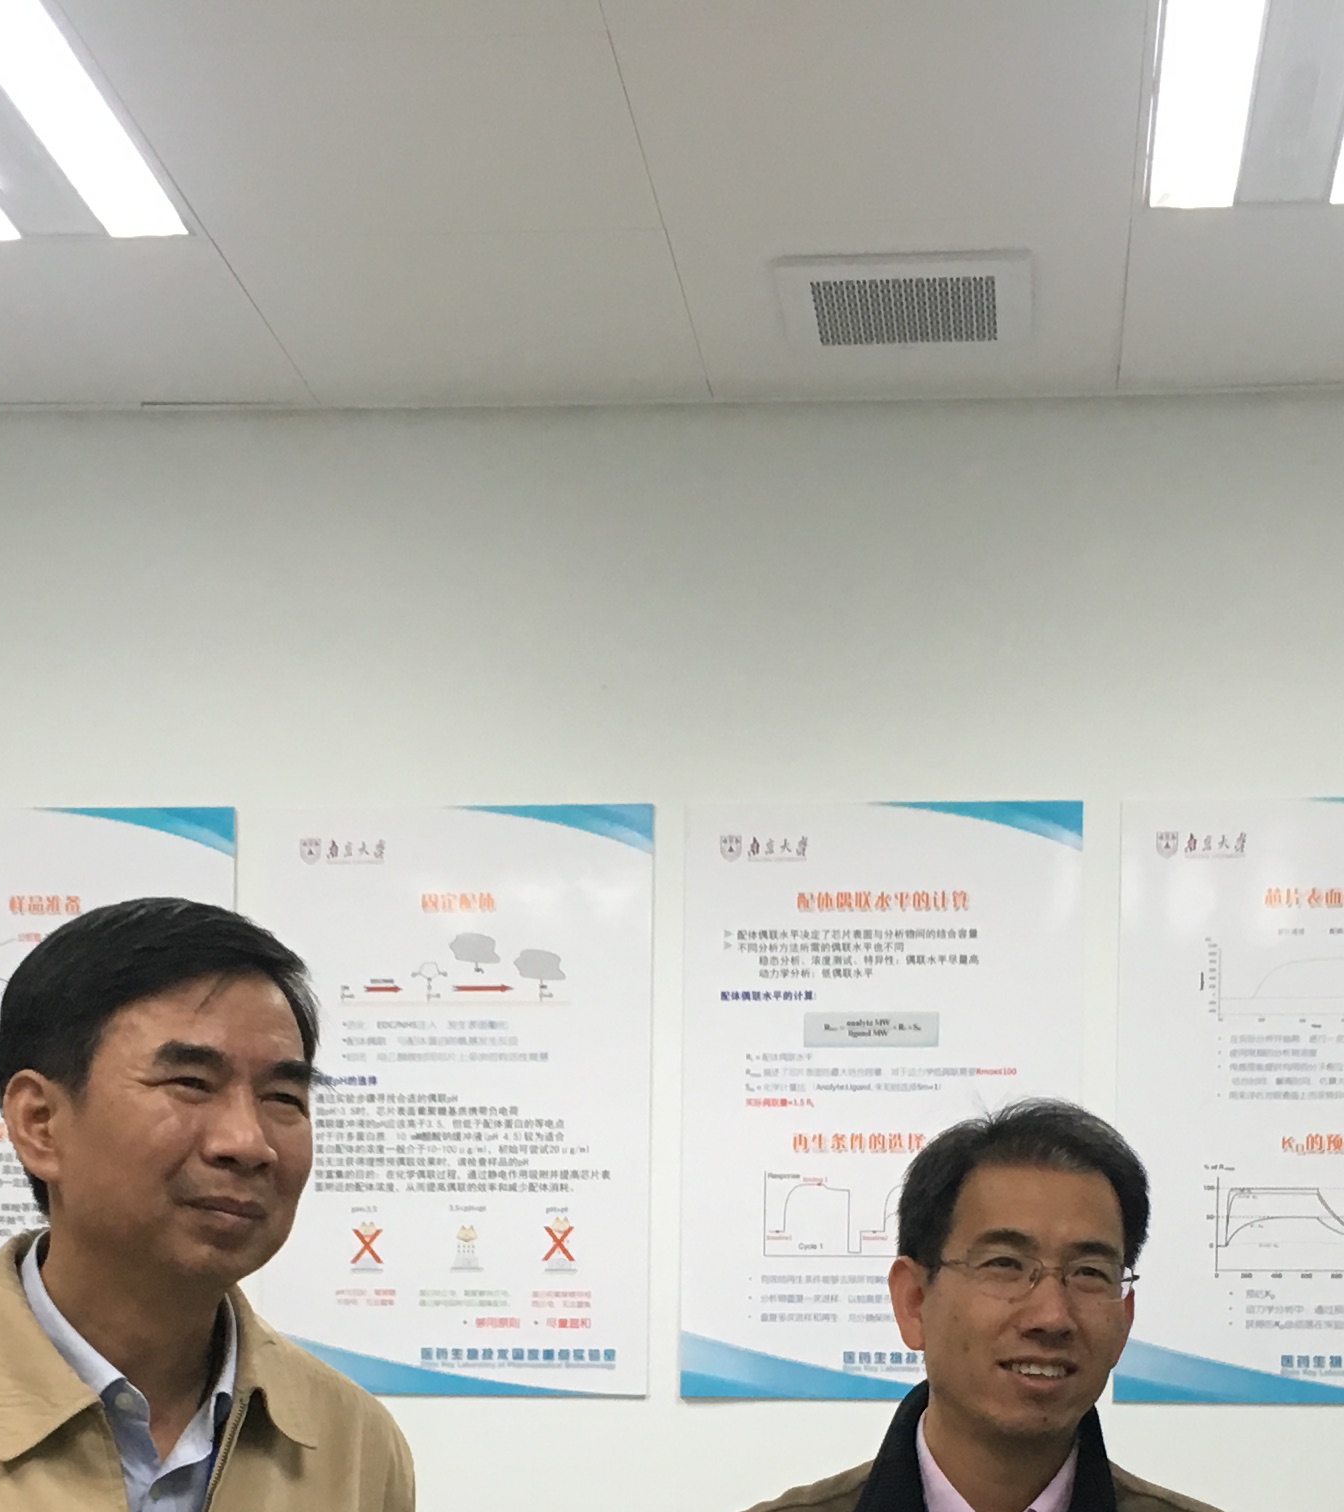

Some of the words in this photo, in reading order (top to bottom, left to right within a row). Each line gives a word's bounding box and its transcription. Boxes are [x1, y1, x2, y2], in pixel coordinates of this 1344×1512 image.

[796, 890, 970, 912] 配体偶联水平的计算
[792, 1133, 926, 1154] 再生条件的选择
